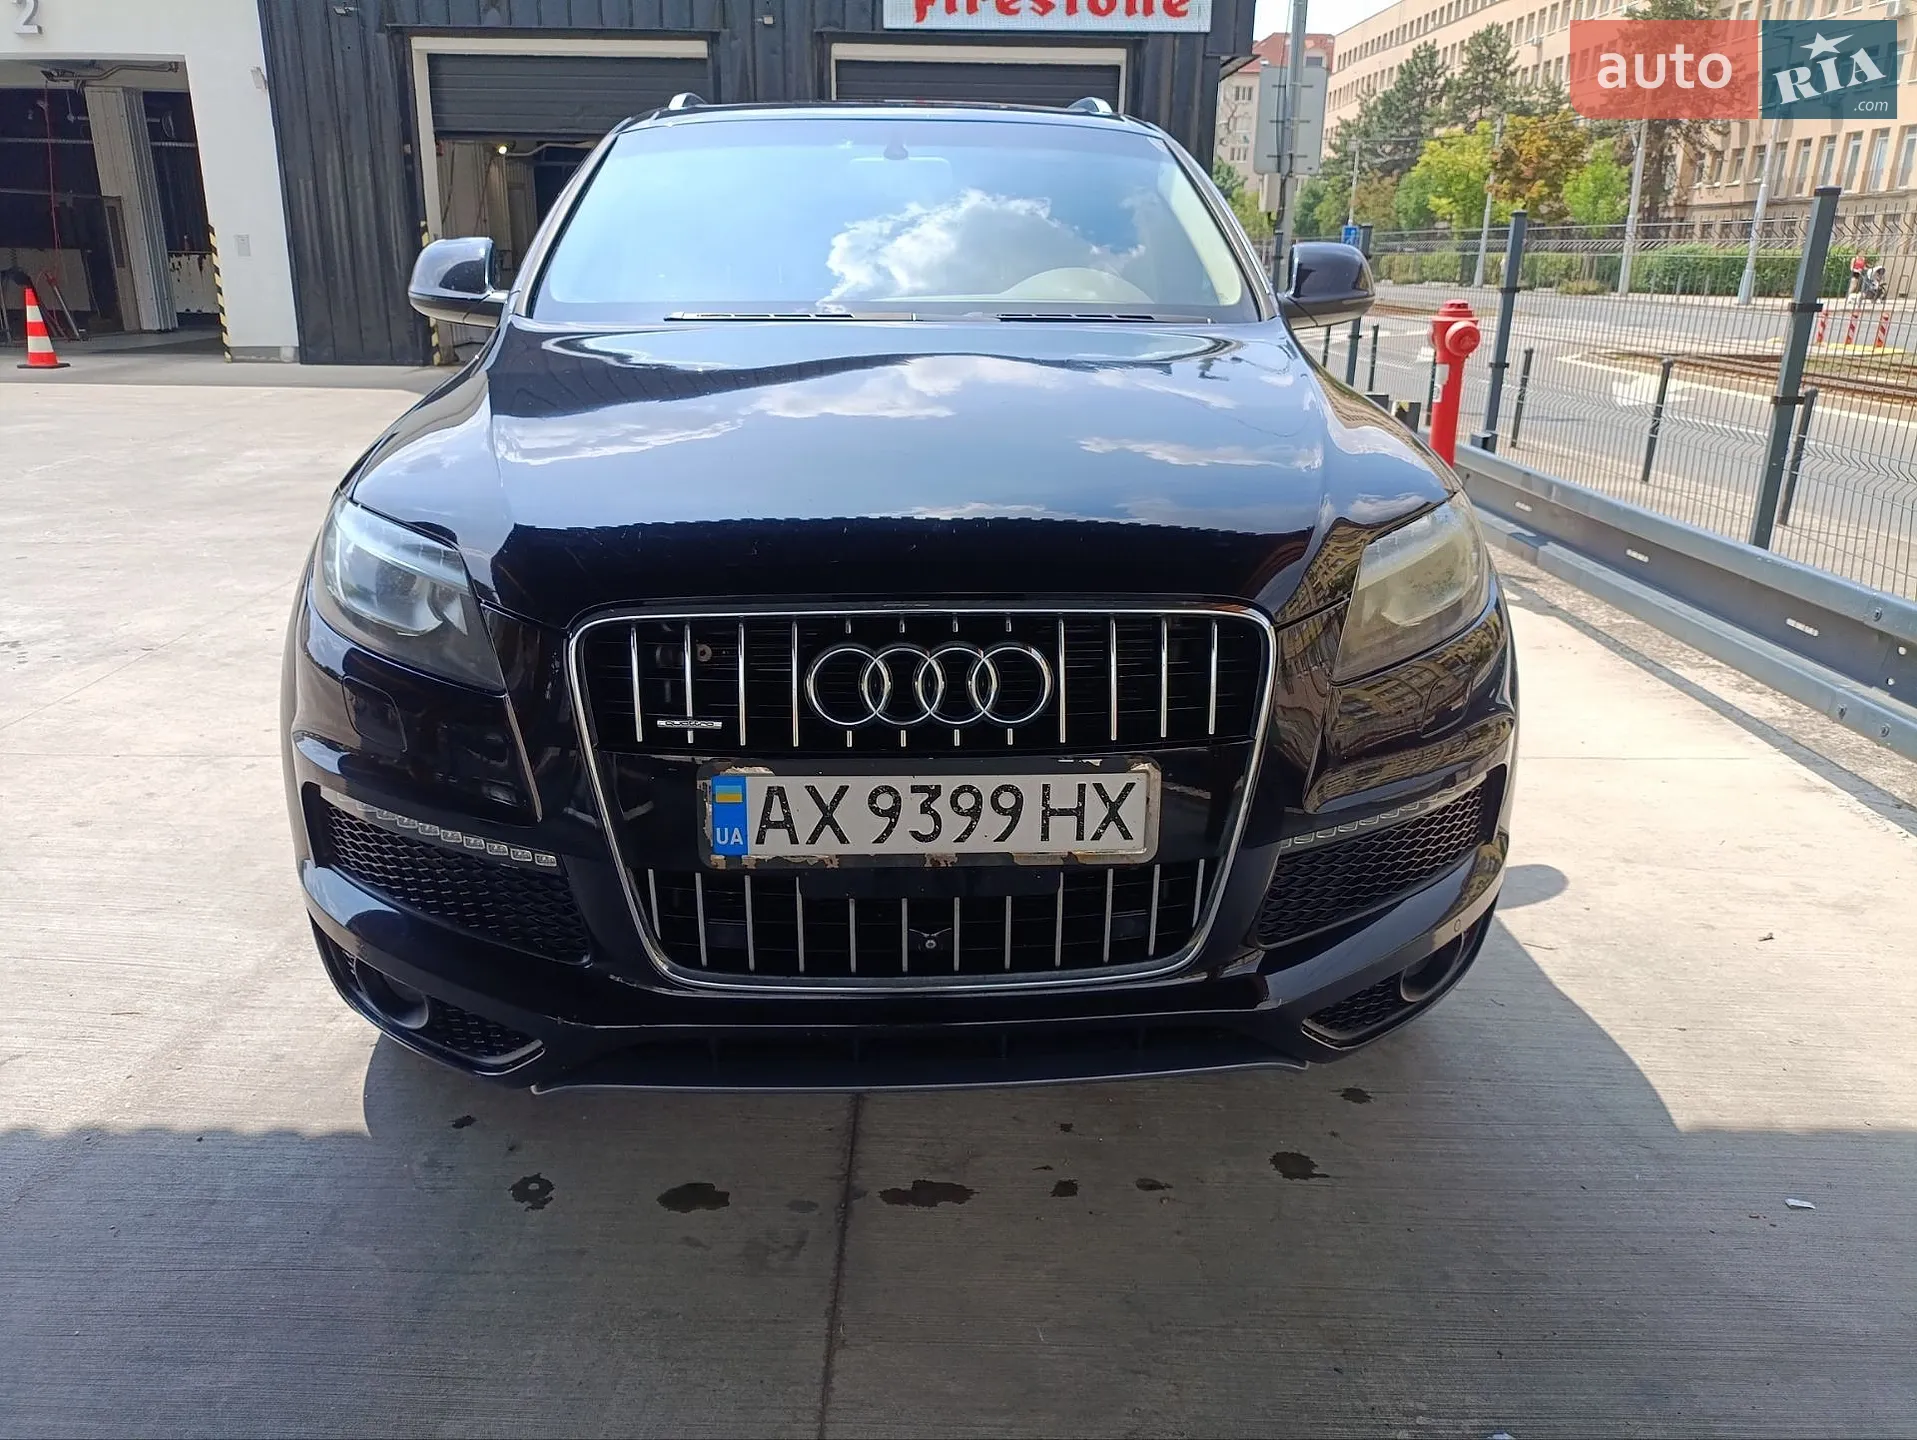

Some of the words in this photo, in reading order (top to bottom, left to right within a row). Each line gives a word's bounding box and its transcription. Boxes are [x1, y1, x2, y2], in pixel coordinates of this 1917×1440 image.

[14, 0, 42, 35] 2
[755, 785, 850, 845] AX
[867, 784, 1024, 844] 9399
[1040, 782, 1137, 842] HX
[716, 827, 744, 845] UA
